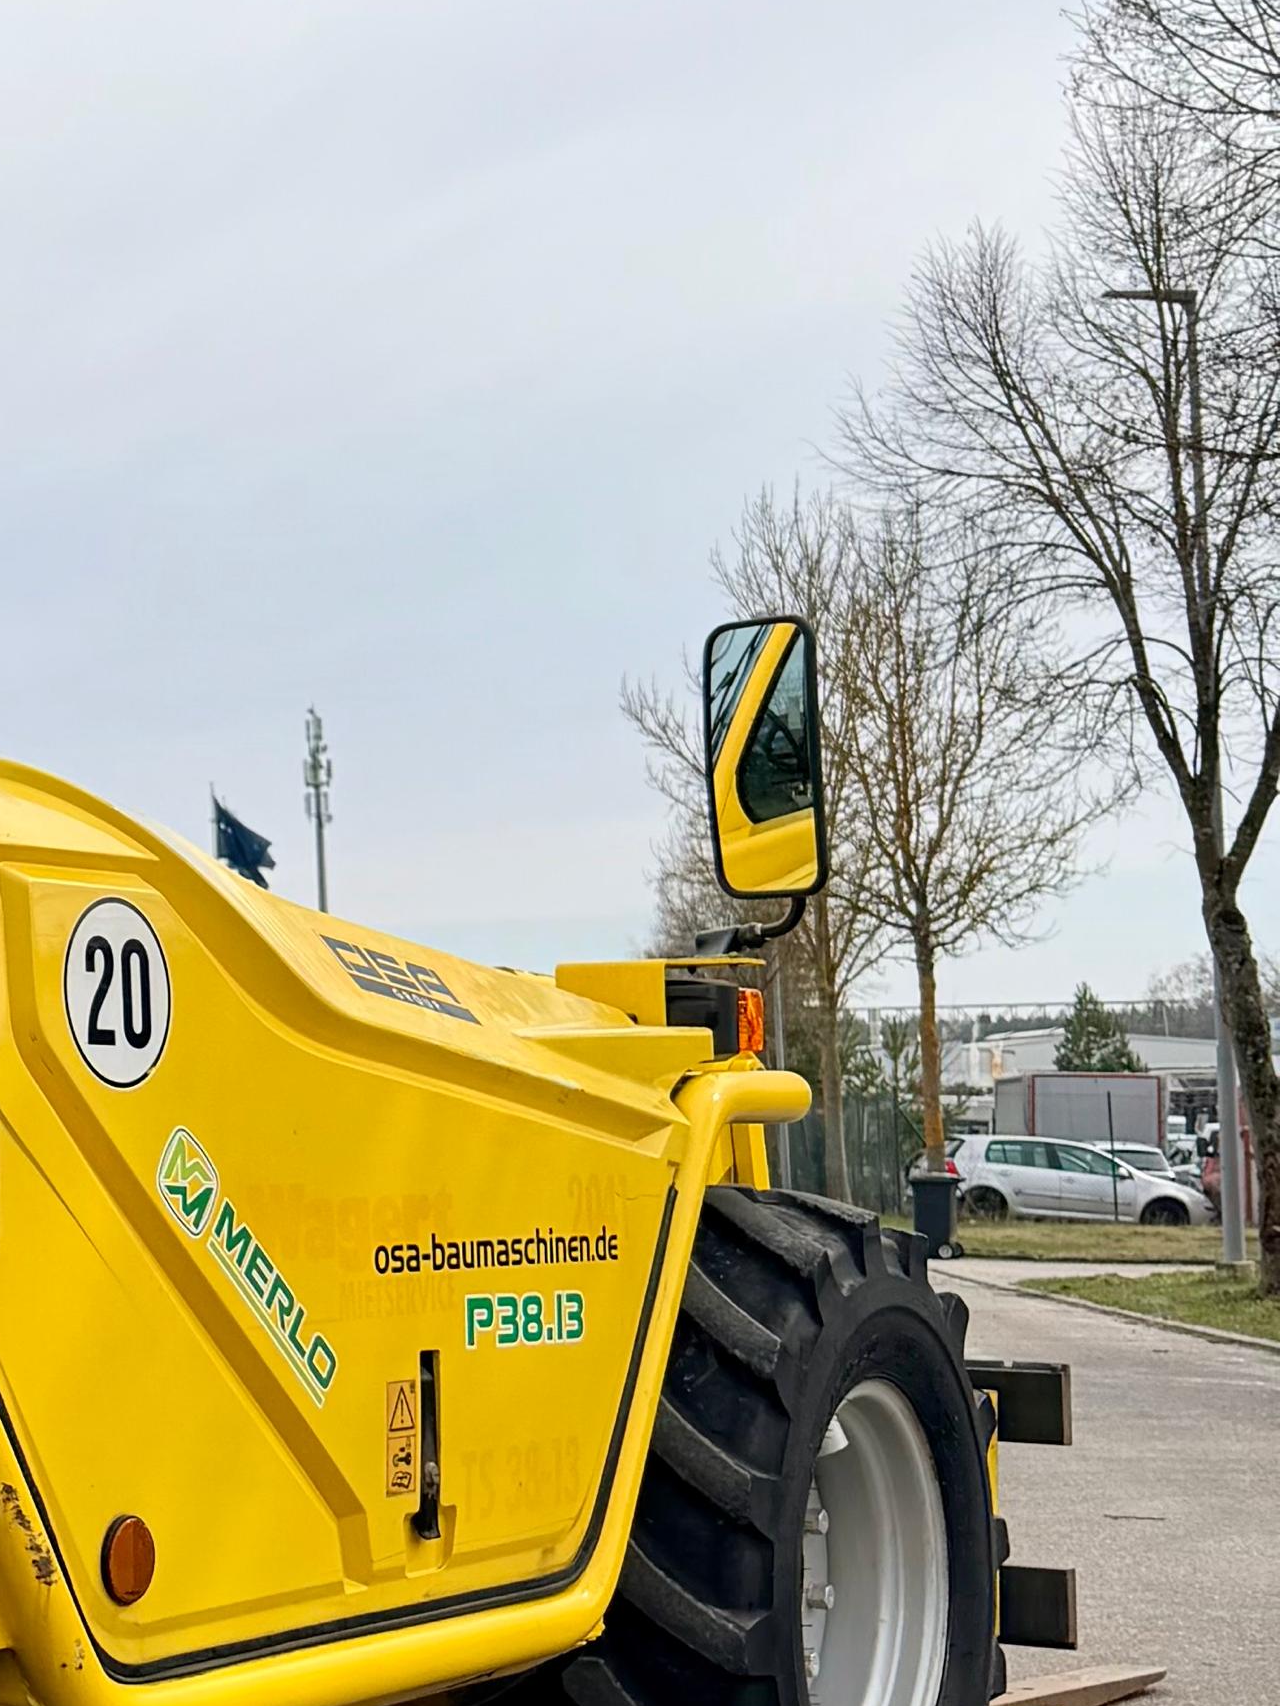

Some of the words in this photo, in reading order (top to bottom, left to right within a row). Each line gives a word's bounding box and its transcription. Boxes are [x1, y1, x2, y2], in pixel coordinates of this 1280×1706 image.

[84, 936, 152, 1050] 20
[374, 1225, 619, 1275] osa-baumaschinen.de
[213, 1200, 336, 1390] MERLO
[466, 1292, 584, 1347] P38.13
